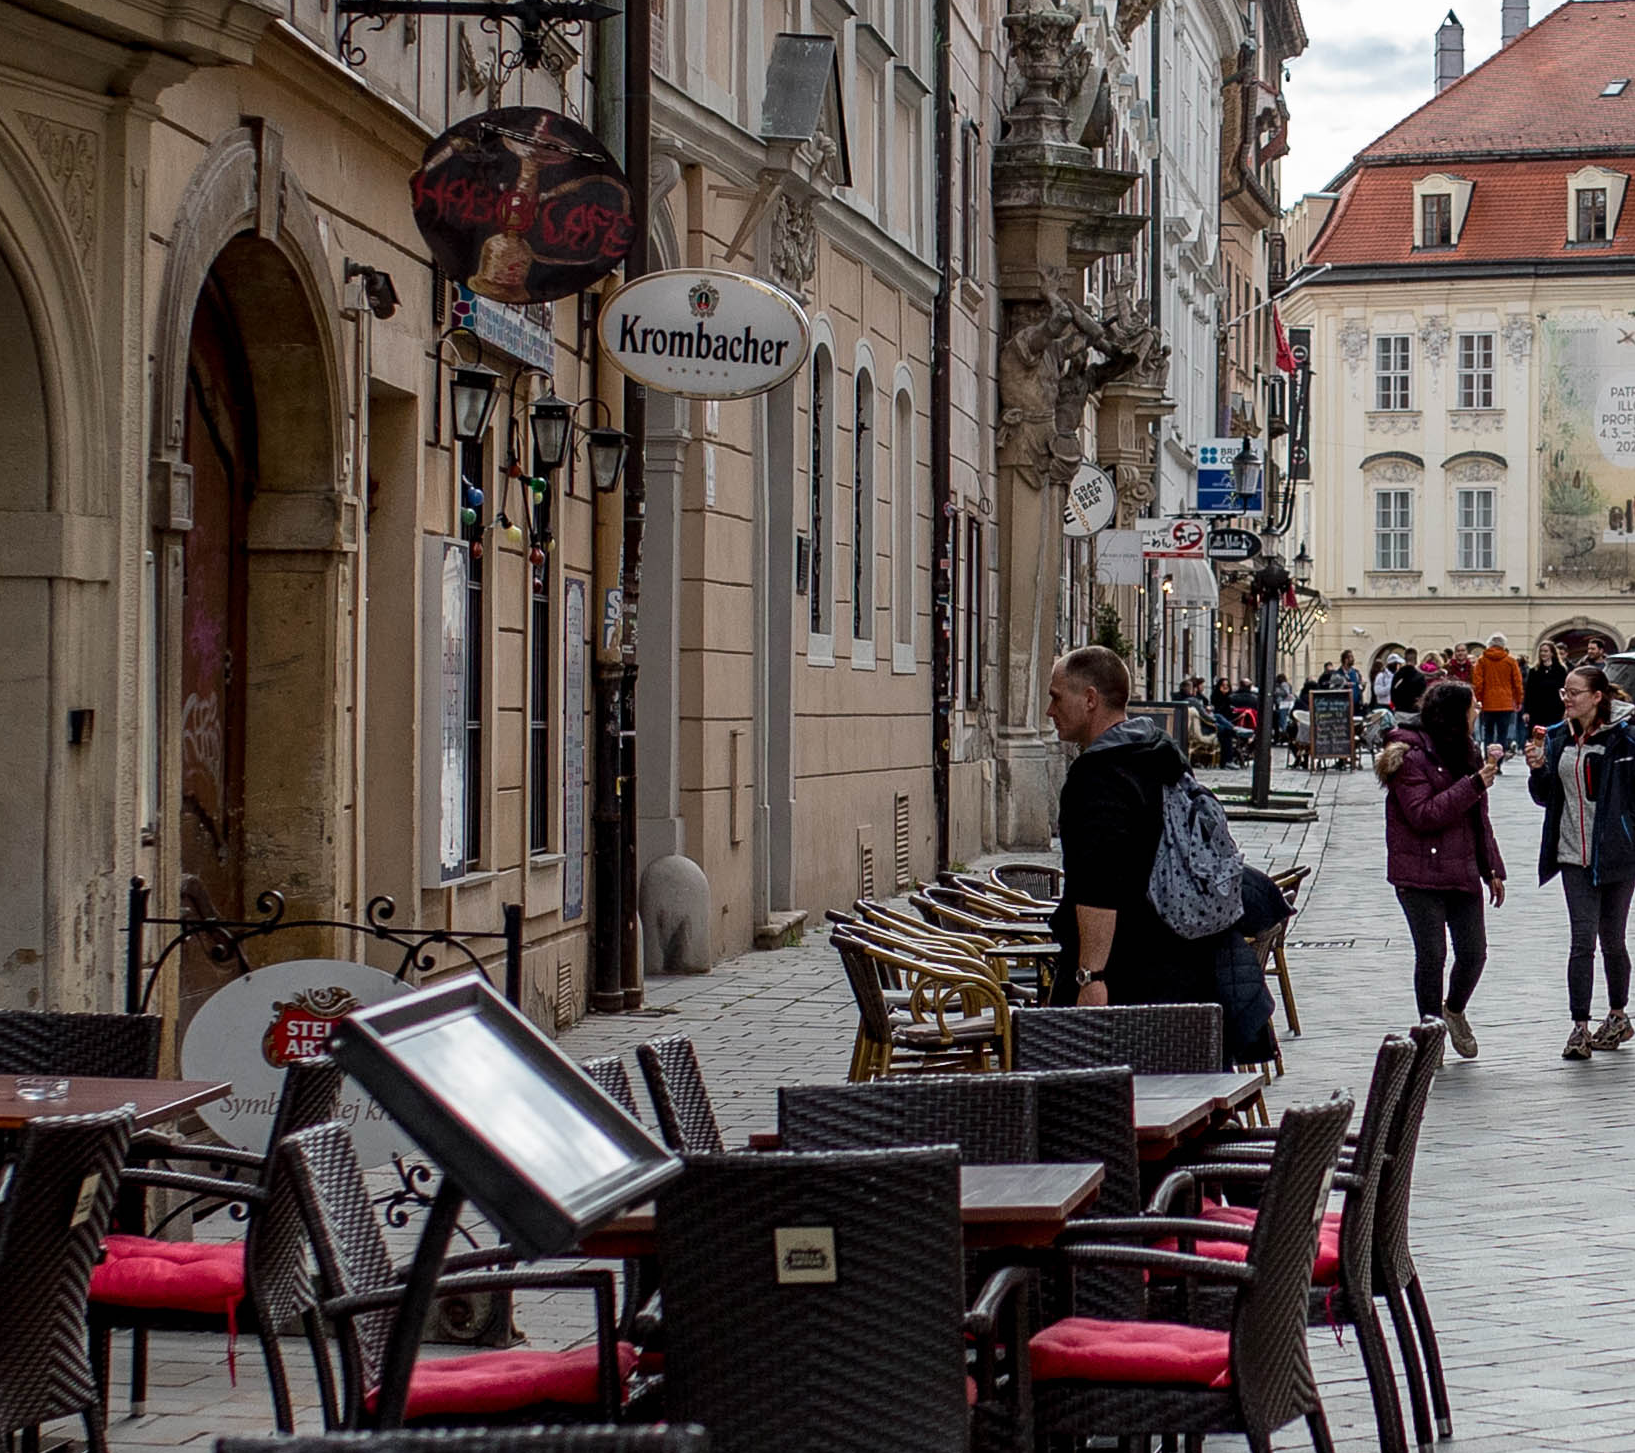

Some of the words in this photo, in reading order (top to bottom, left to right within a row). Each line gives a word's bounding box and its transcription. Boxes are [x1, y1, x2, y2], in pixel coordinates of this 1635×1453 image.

[618, 313, 790, 367] Krombacher
[1073, 476, 1103, 496] CRAFT
[1078, 486, 1102, 503] BEER
[1082, 495, 1101, 510] BAR
